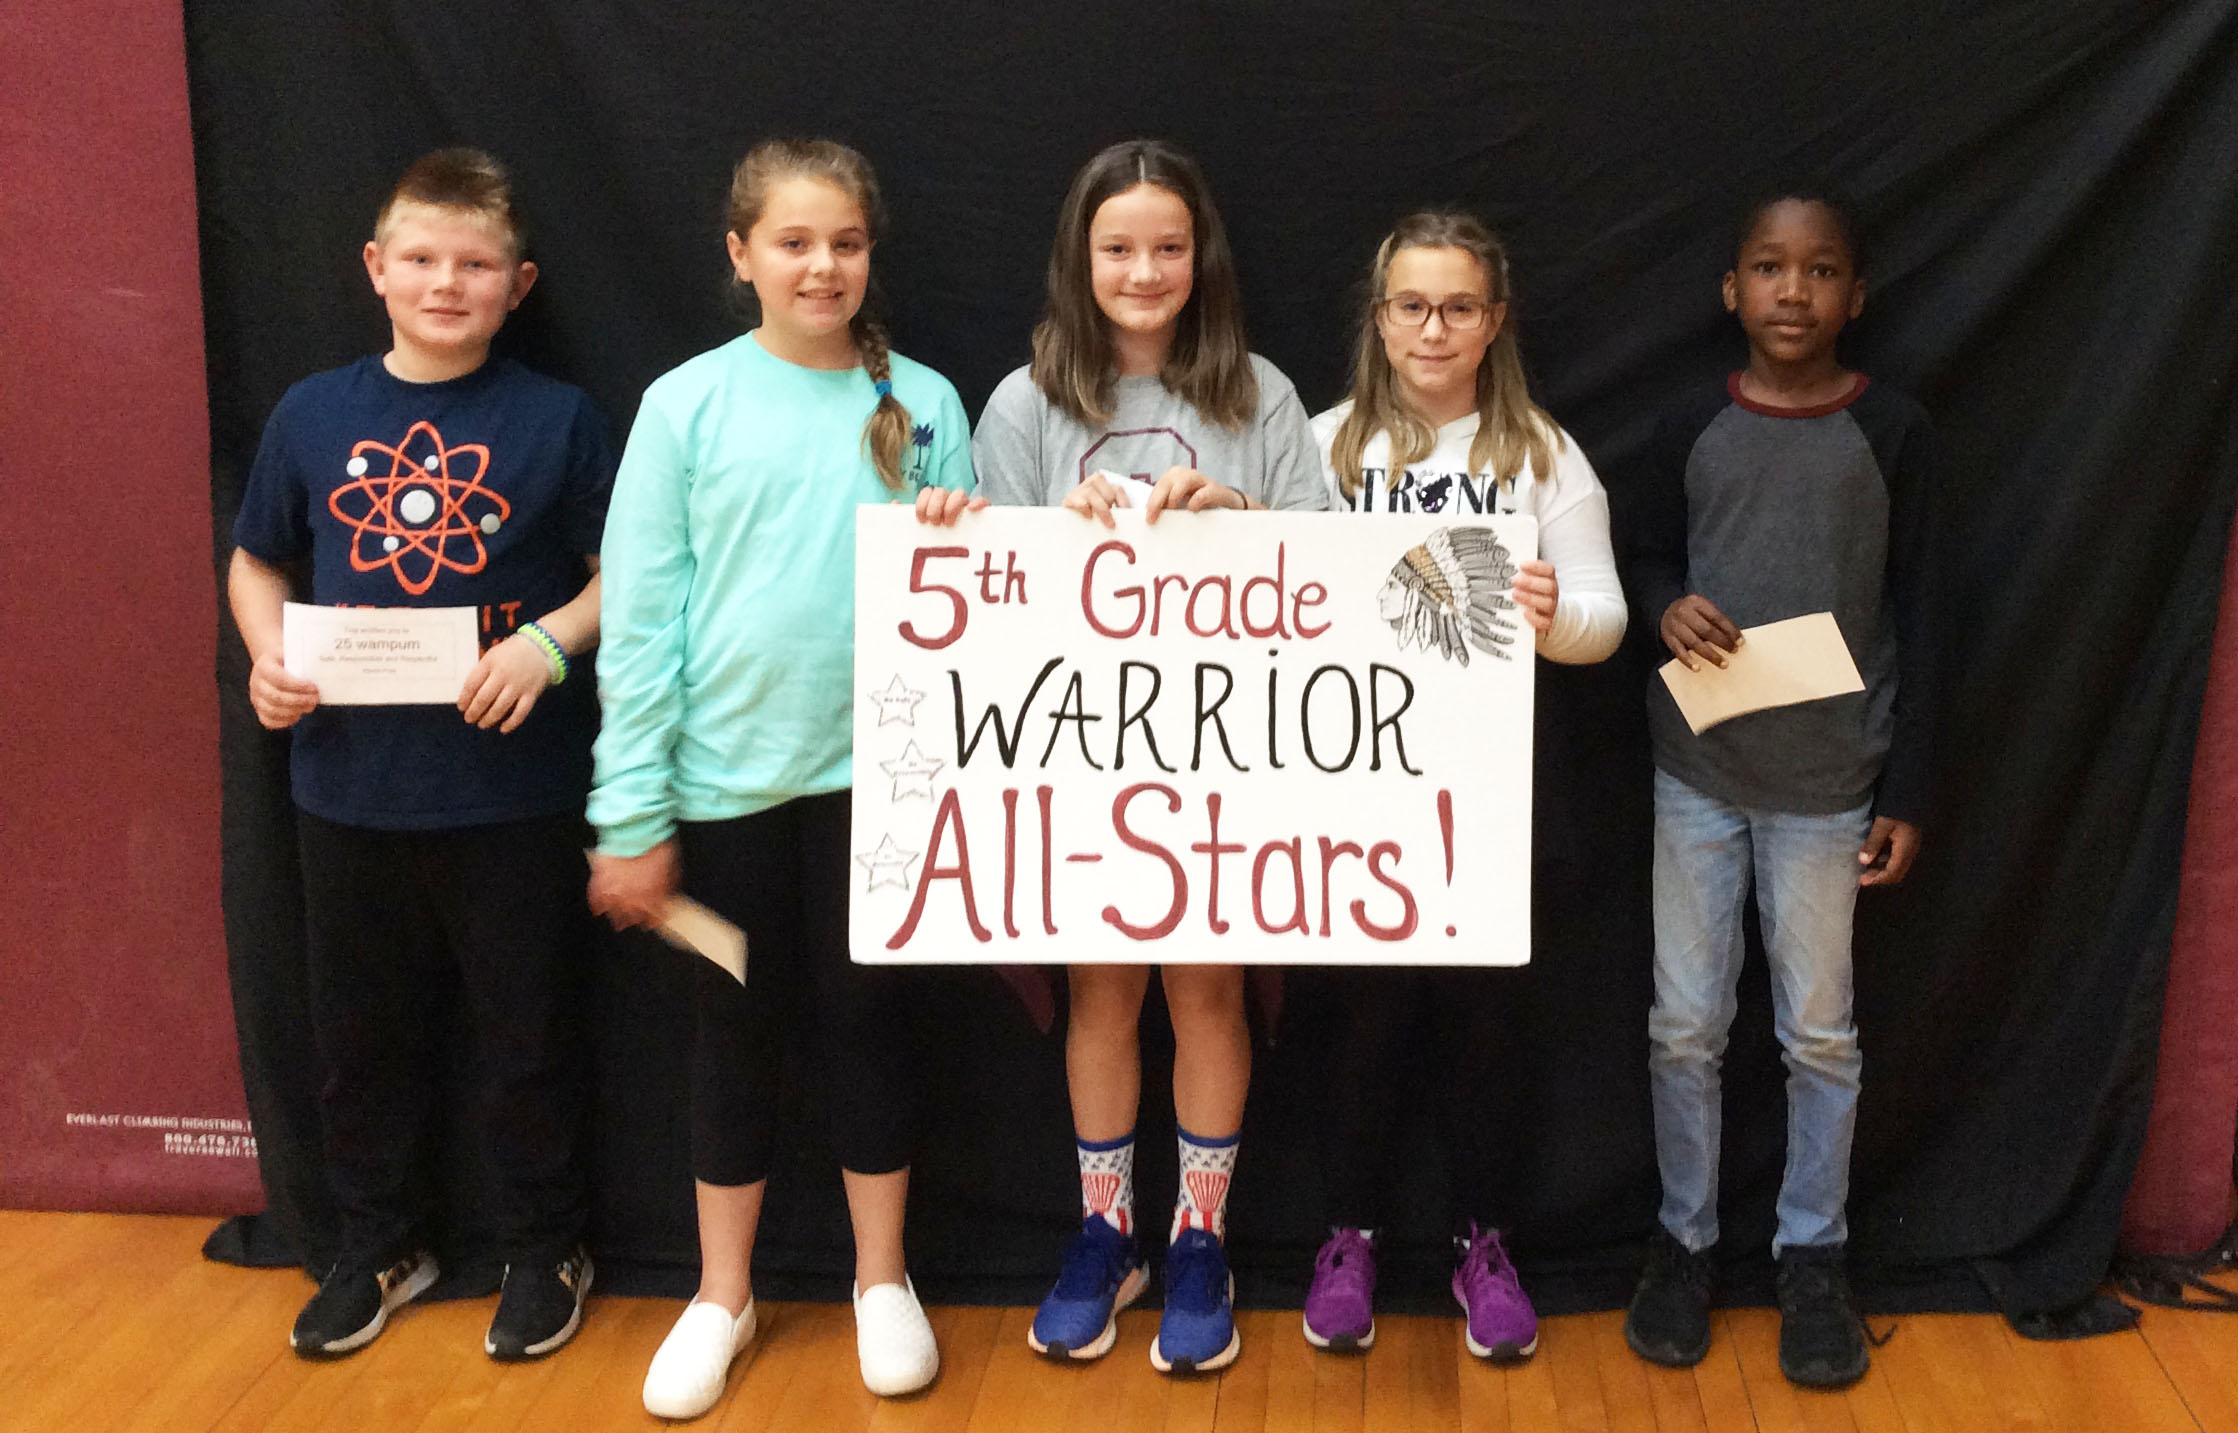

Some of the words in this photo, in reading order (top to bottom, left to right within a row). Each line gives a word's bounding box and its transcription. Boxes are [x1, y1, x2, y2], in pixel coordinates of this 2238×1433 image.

[898, 545, 1028, 651] 5th
[1081, 540, 1332, 641] Grade
[482, 601, 522, 632] IT
[335, 637, 353, 650] 25
[356, 639, 421, 652] wampum
[66, 1112, 120, 1127] EVERLAST
[123, 1114, 179, 1129] CLIMBING
